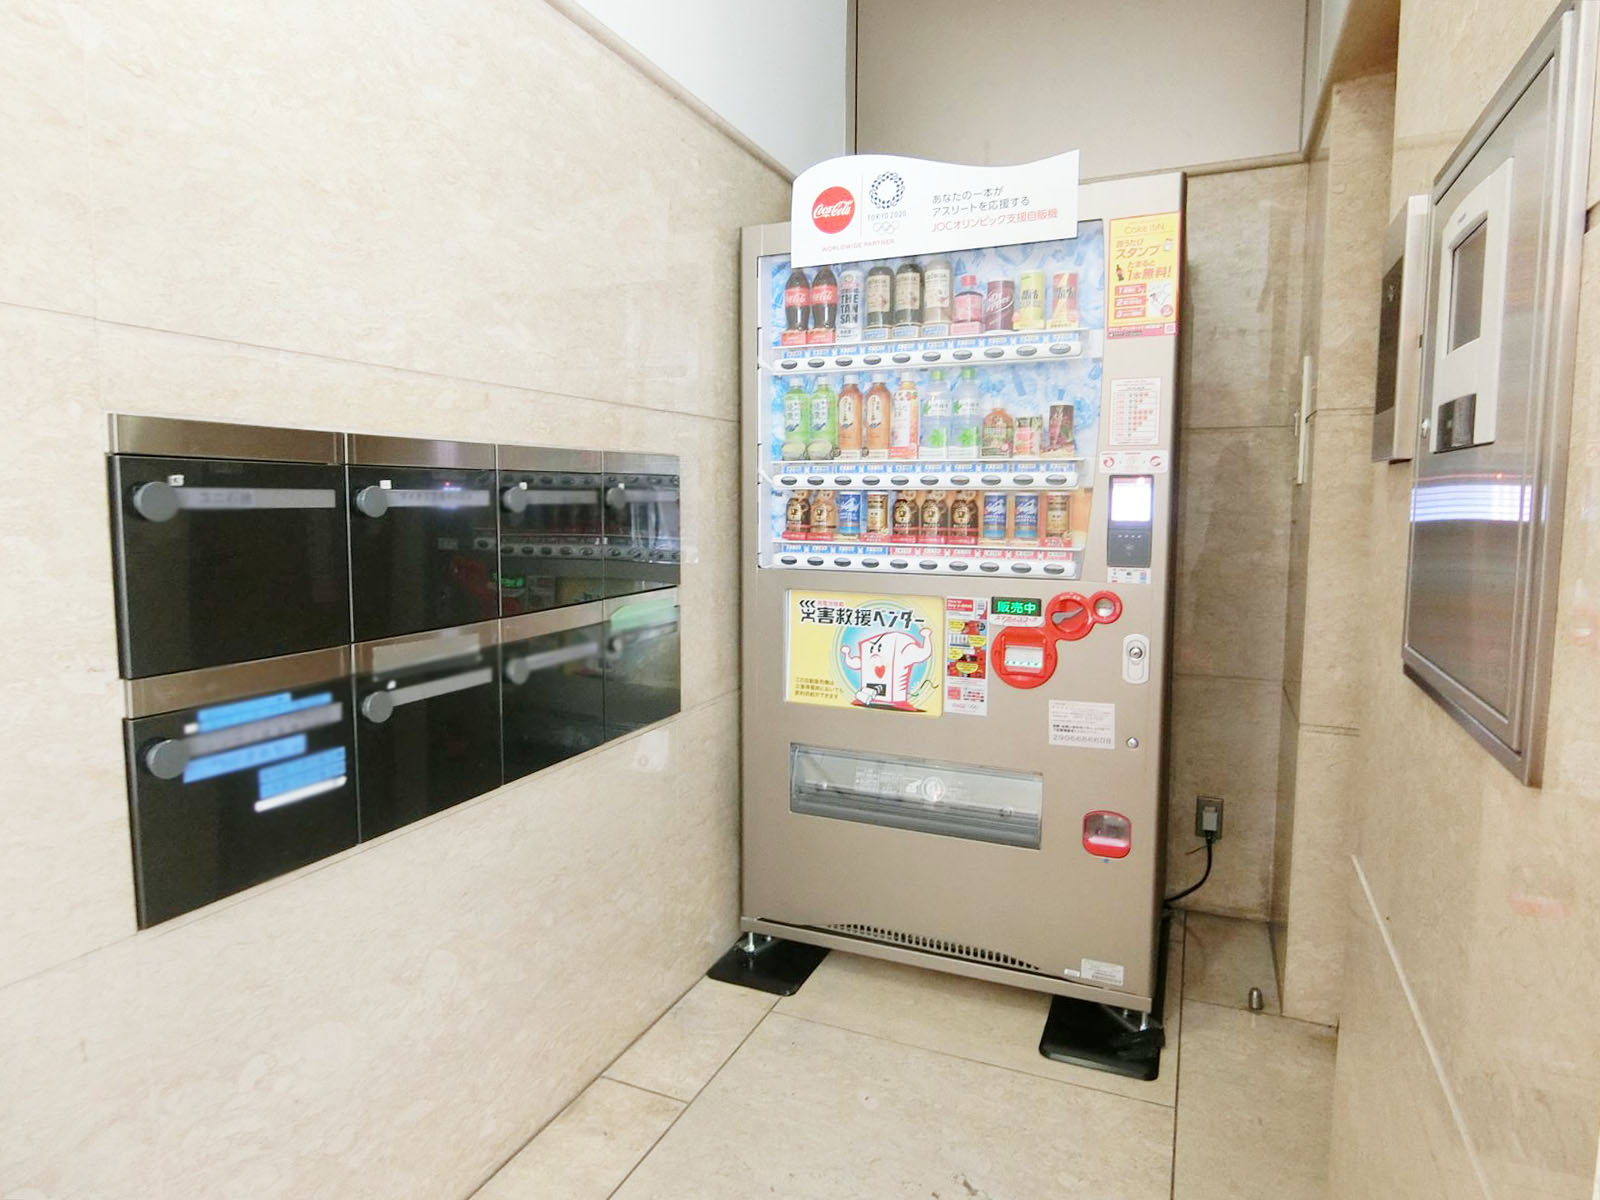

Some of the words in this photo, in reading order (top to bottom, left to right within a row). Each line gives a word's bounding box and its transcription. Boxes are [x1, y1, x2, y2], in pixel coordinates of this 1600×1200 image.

[932, 186, 1004, 204] あなたの一本が
[813, 199, 854, 219] Coca-Cola
[932, 196, 1030, 217] アスリートを応援する
[867, 213, 888, 222] TOKYO
[890, 210, 908, 219] 2020
[931, 208, 1058, 232] JOCオリンピック支援自販機
[822, 242, 862, 252] WORLDWIDE
[864, 239, 895, 249] PARTNER
[841, 294, 859, 304] THE
[840, 303, 859, 313] TAN
[840, 314, 858, 325] SAN
[799, 600, 925, 628] 災害救援ベンダー
[997, 600, 1036, 614] 販売中
